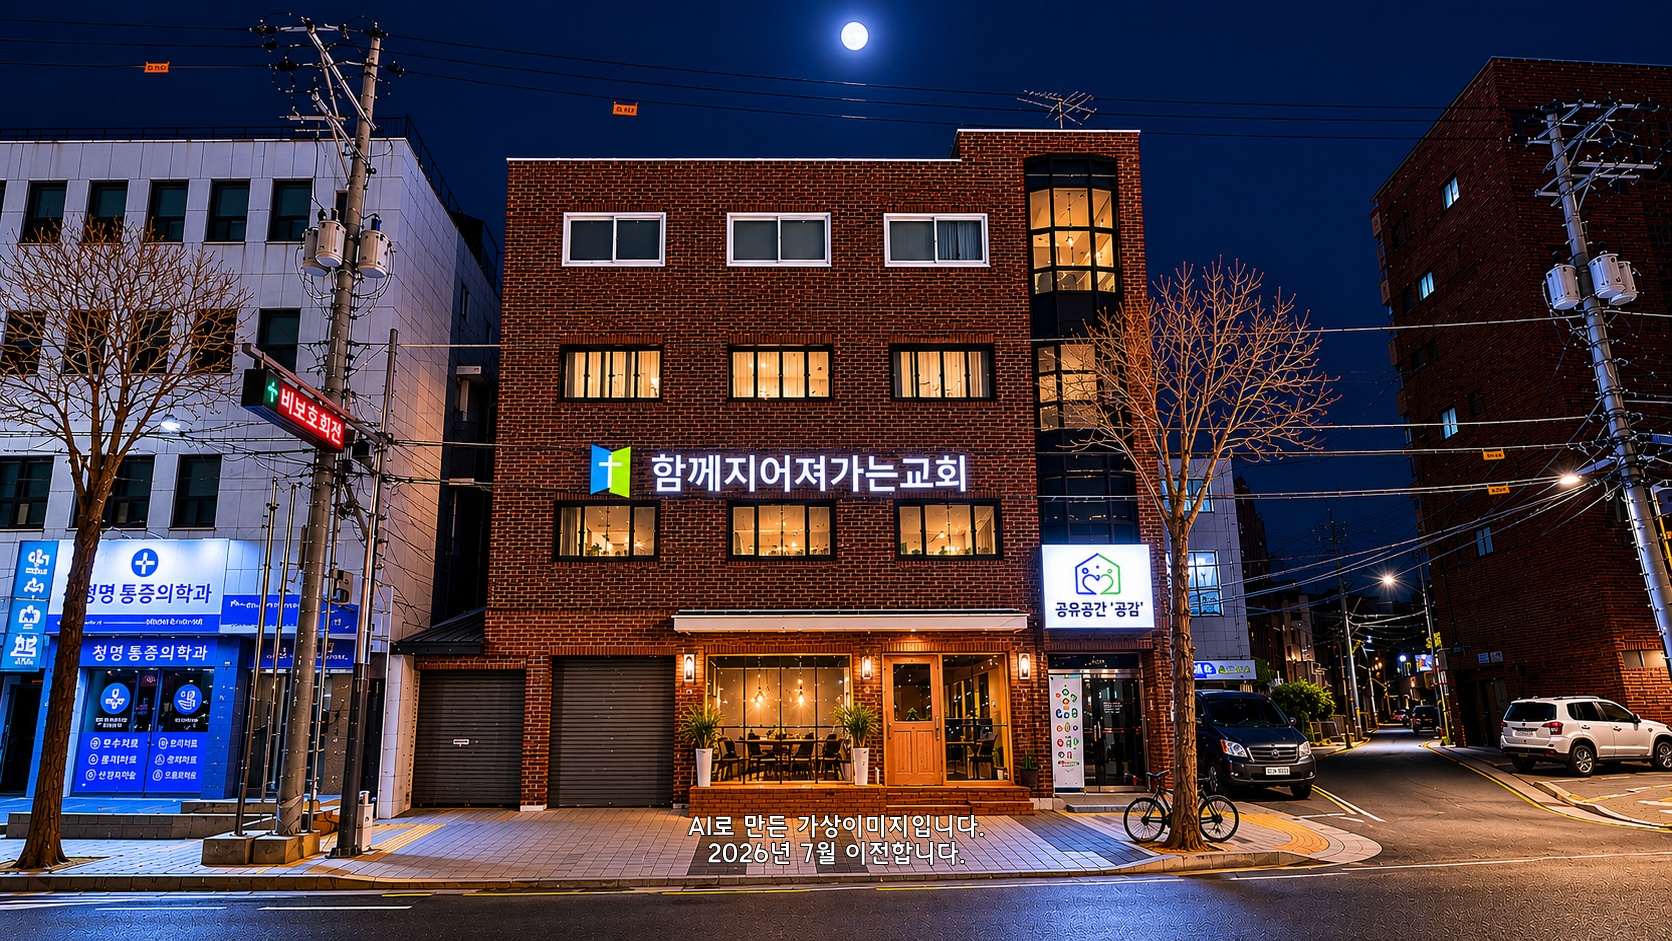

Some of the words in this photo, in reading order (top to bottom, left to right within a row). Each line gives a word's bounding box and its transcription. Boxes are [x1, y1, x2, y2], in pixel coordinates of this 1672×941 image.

[281, 388, 341, 444] 비보호회전
[651, 453, 967, 493] 함께지어져가는교회
[119, 583, 213, 604] 통증의학과
[1055, 601, 1107, 618] 공유공간
[1110, 601, 1143, 618] '공감'
[92, 644, 123, 661] 청명
[127, 644, 208, 661] 통증의학과
